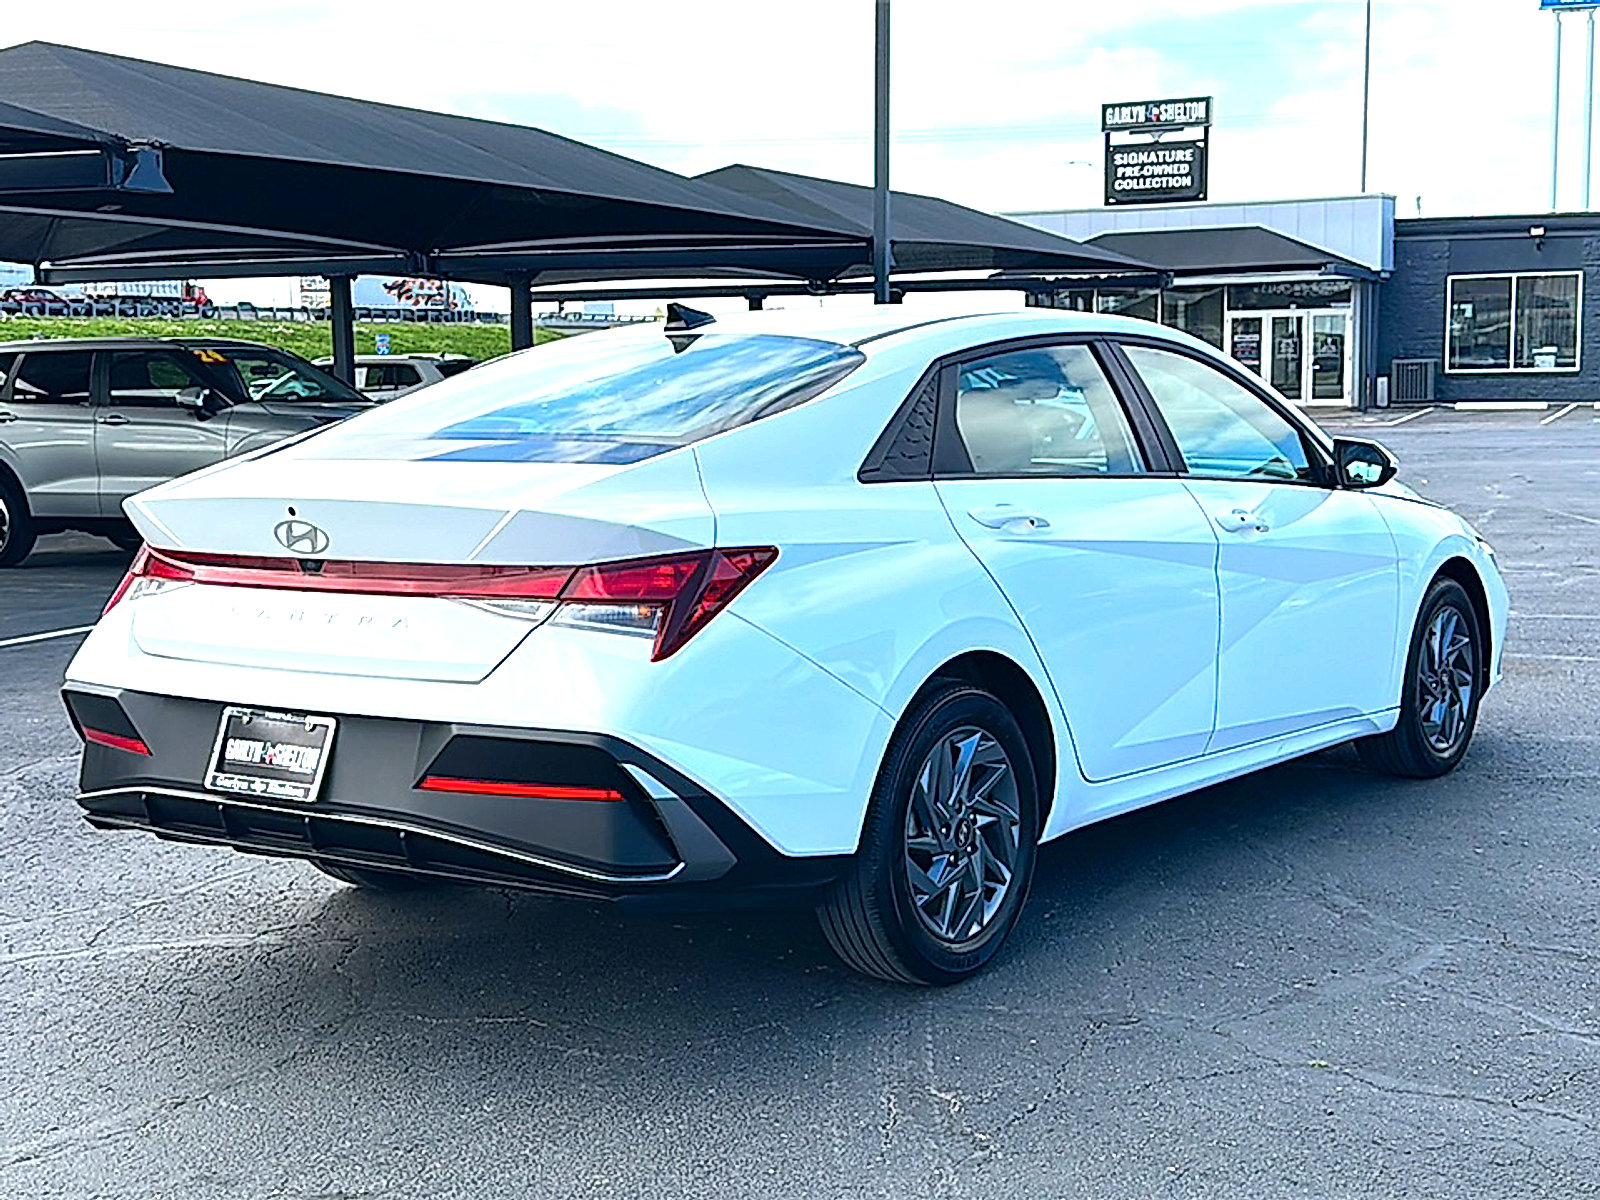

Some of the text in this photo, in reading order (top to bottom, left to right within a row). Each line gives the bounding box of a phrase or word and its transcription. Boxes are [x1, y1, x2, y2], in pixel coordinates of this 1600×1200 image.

[1106, 102, 1206, 125] GARLYN SHELTON
[1113, 148, 1194, 165] SIGNATURE
[1116, 163, 1189, 177] PRE-OWNED
[1114, 175, 1191, 190] COLLECTION
